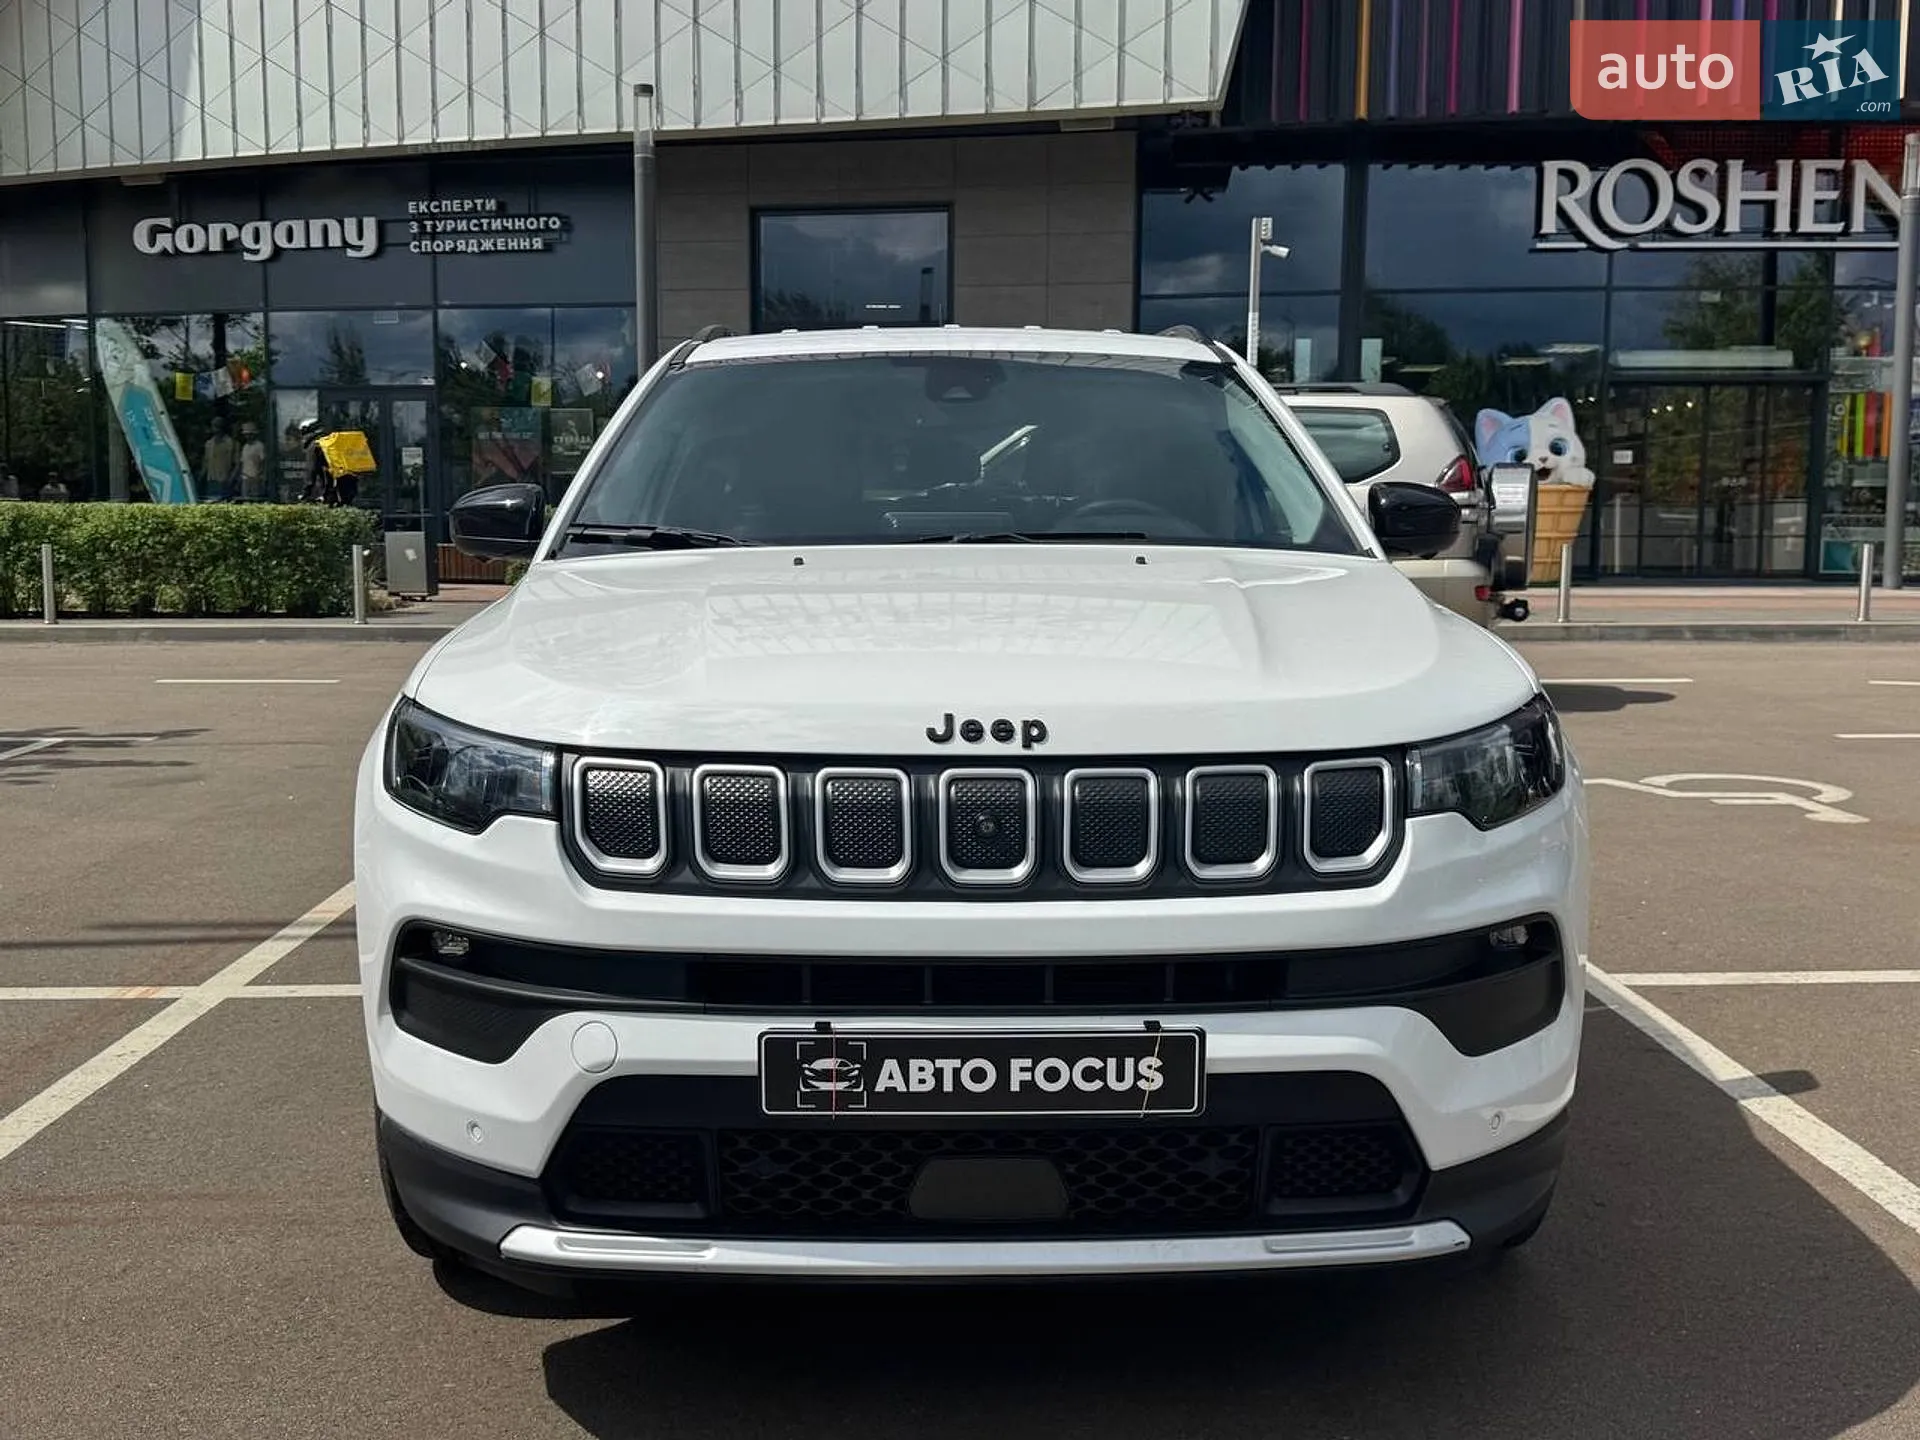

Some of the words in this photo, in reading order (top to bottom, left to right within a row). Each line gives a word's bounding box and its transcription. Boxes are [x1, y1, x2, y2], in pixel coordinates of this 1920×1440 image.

[408, 198, 498, 213] ЕКСПЕРТИ
[1540, 158, 1901, 249] ROSHEN
[132, 216, 379, 262] Gorgany
[408, 220, 419, 234] З
[423, 216, 561, 233] ТУРИСТИЧНОГО
[409, 237, 543, 253] СПОРЯДЖЕННЯ
[926, 713, 1048, 749] Jeep
[874, 1058, 998, 1093] АВТО
[1010, 1057, 1165, 1093] FOCUS
